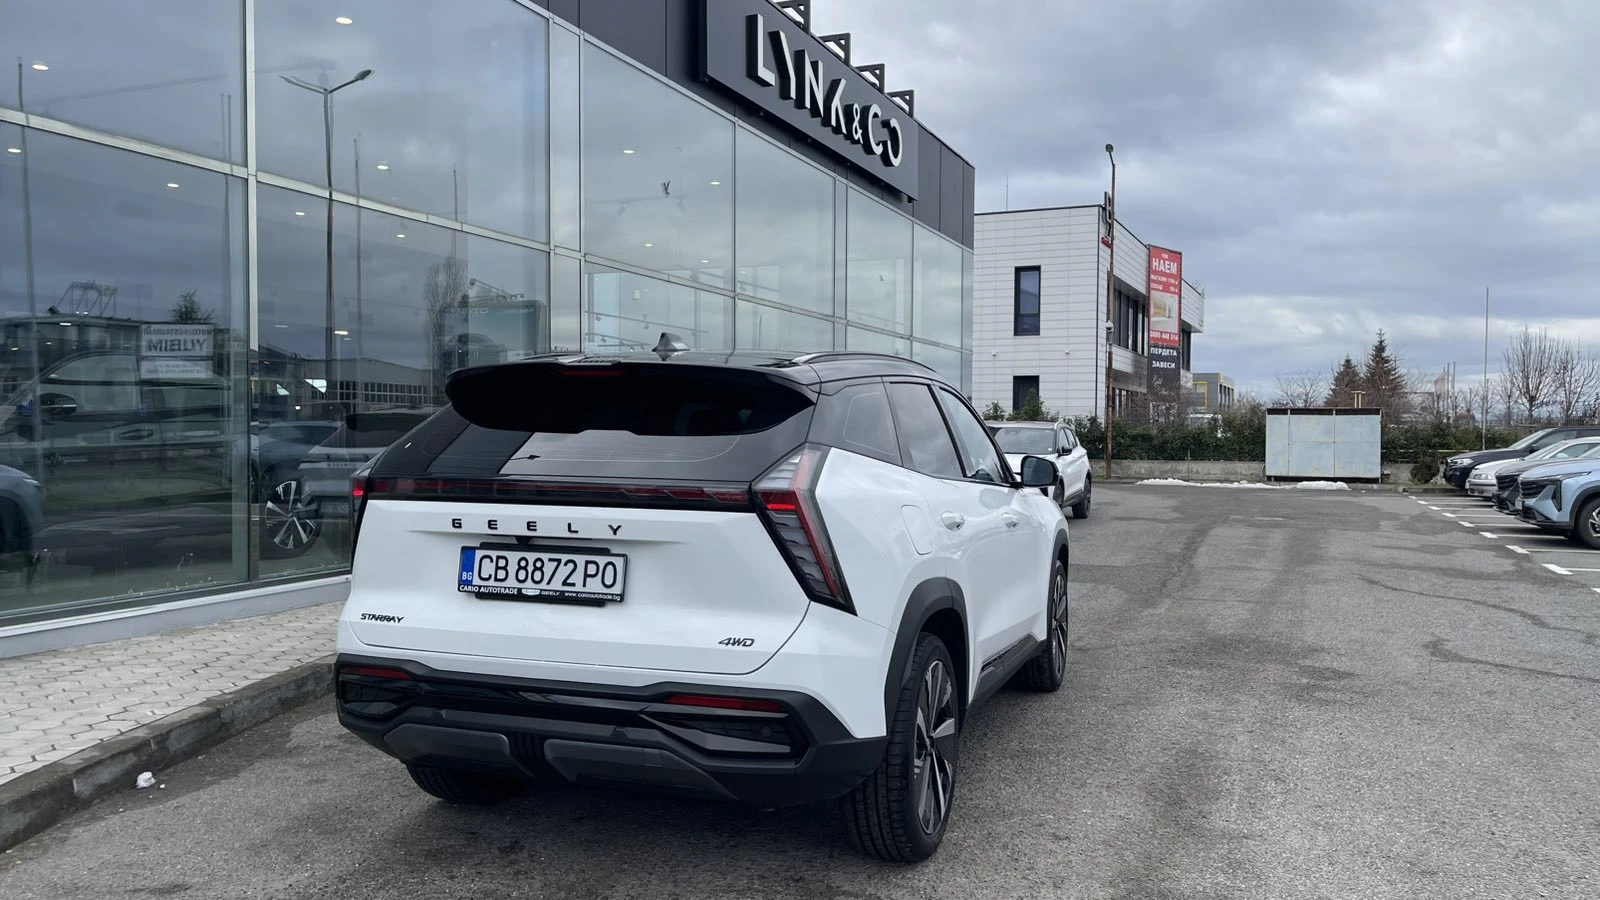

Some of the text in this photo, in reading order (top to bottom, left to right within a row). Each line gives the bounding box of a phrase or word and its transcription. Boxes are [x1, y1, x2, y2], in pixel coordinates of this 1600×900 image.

[1152, 257, 1178, 275] НАЕМ
[1150, 347, 1178, 357] ПЕРДЕТА
[1152, 360, 1176, 369] ЗАВЕСИ
[452, 518, 622, 536] GEELY
[461, 571, 473, 581] BG
[515, 556, 578, 588] 8872
[459, 584, 479, 592] CARIO
[480, 586, 518, 595] AUTOTRADE
[360, 612, 404, 624] STARRAY
[718, 637, 755, 647] 4WD
